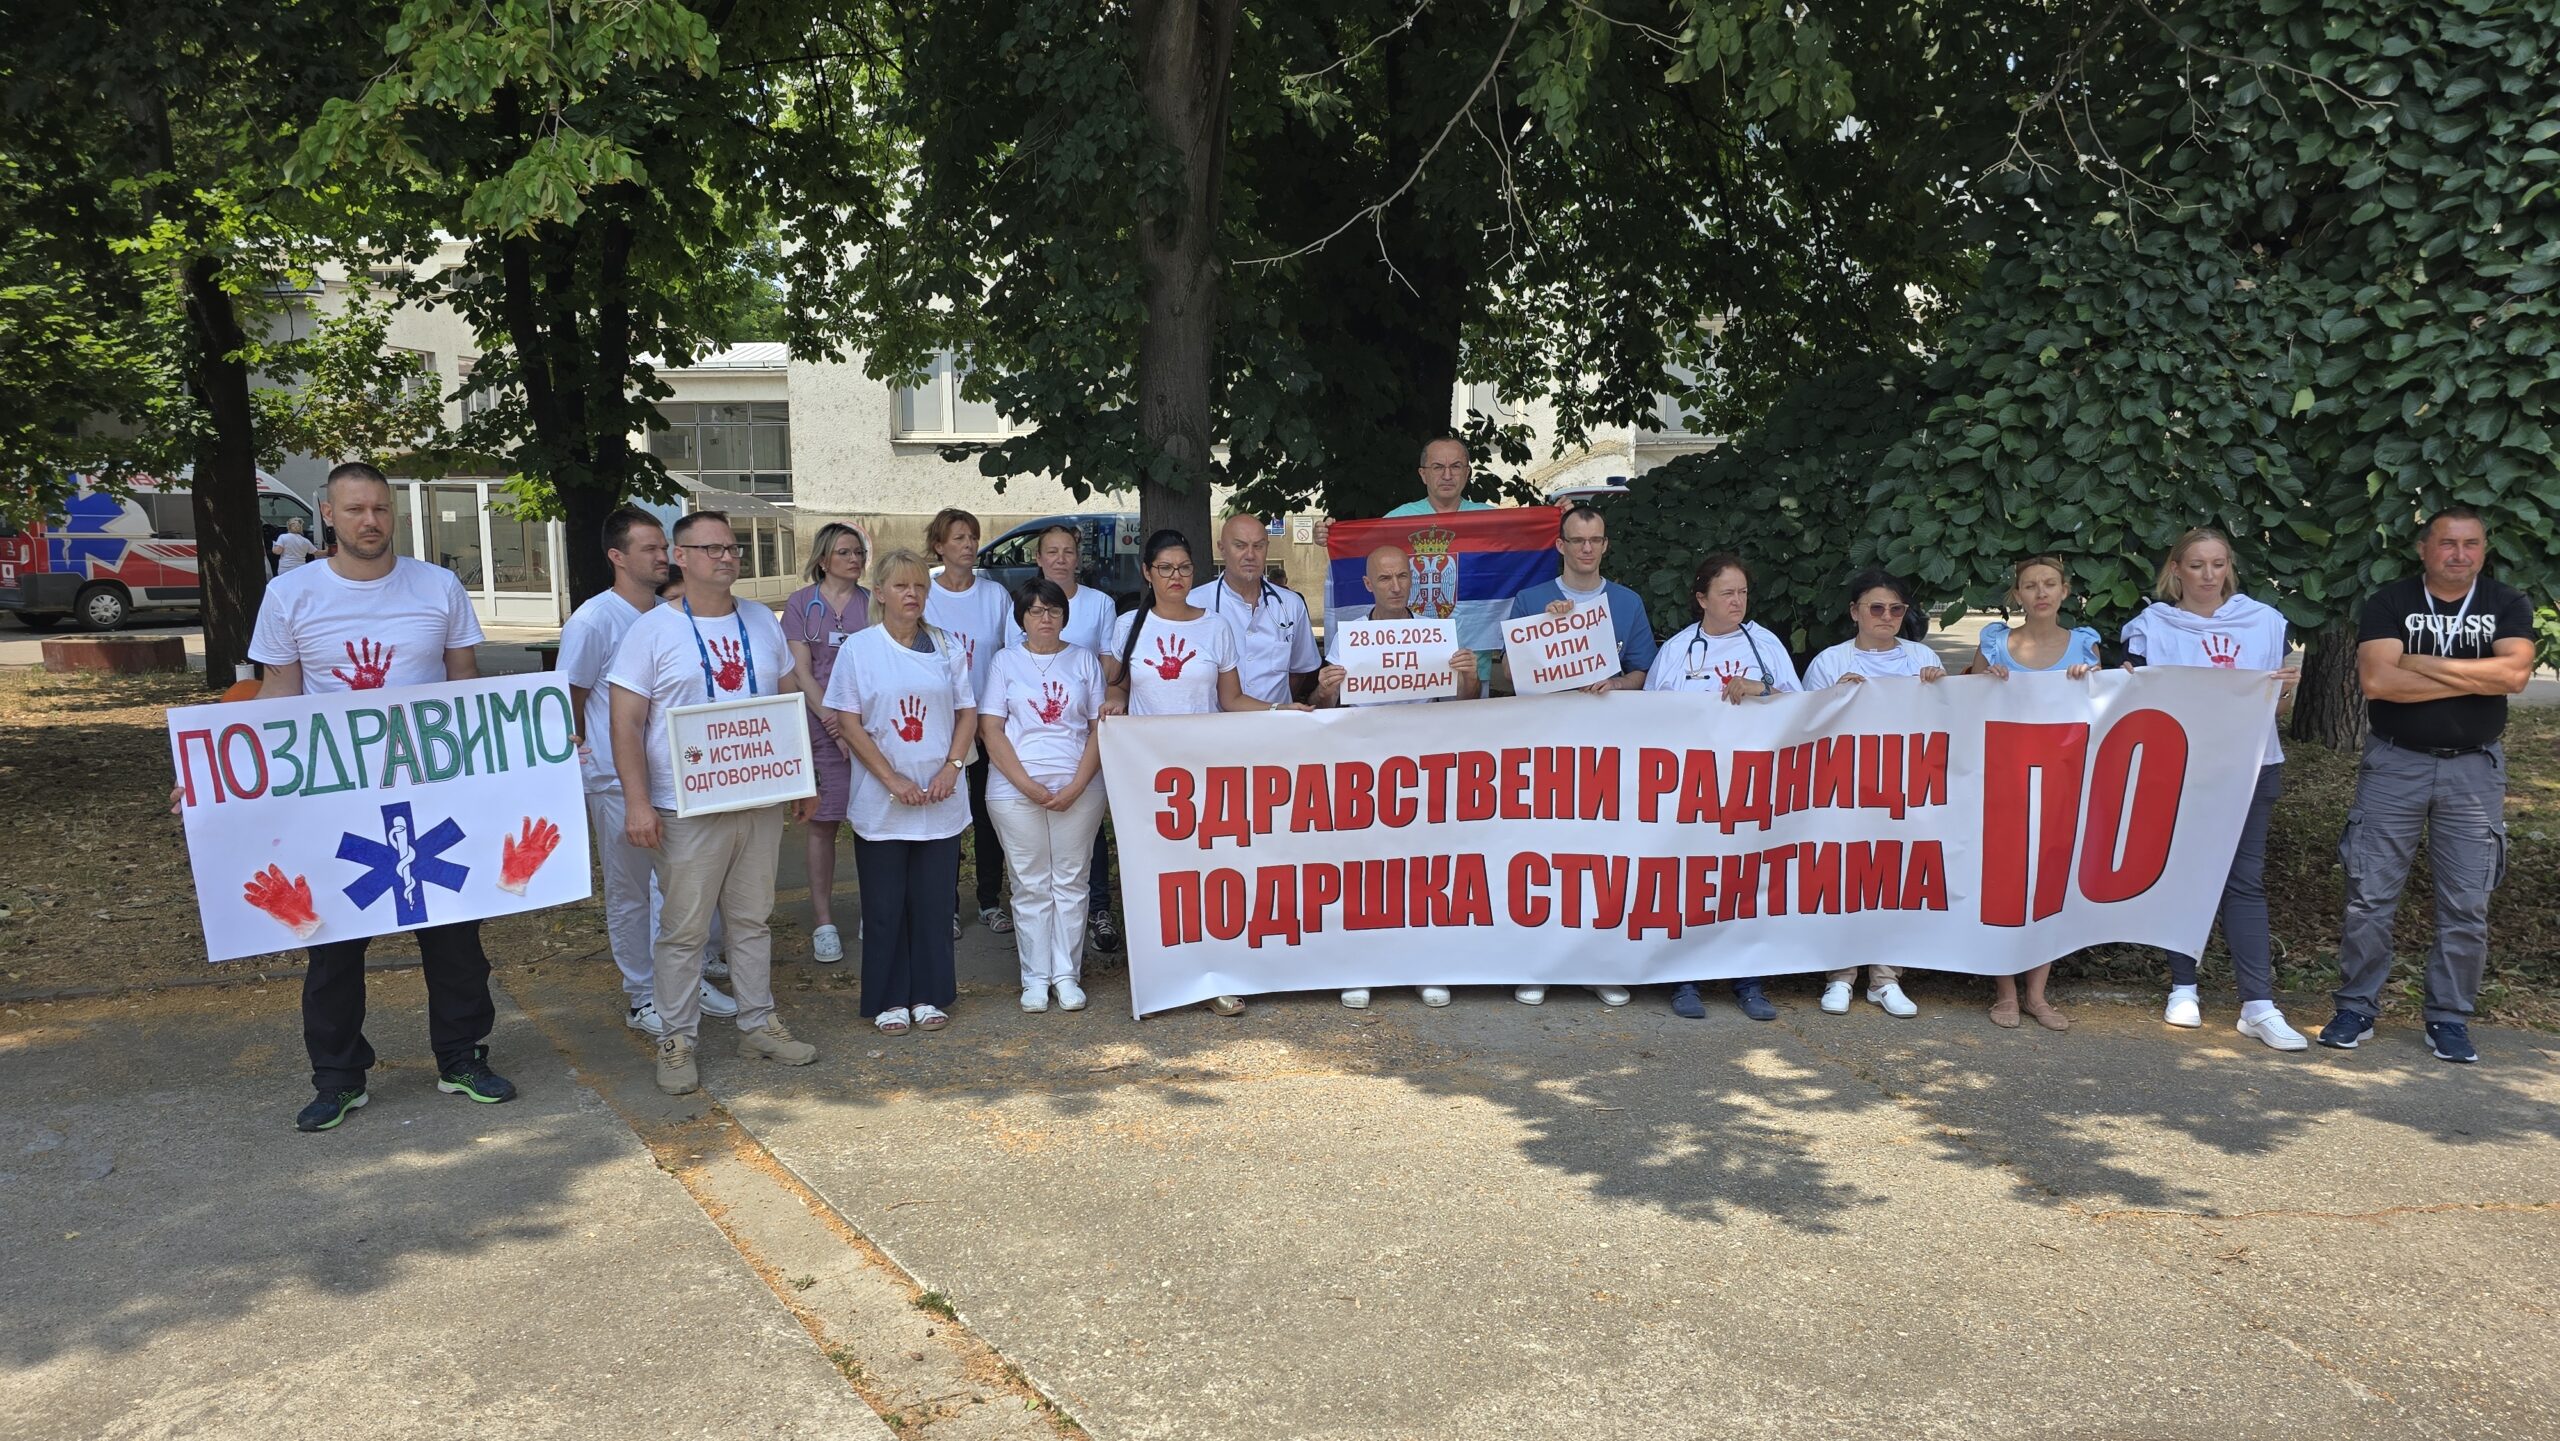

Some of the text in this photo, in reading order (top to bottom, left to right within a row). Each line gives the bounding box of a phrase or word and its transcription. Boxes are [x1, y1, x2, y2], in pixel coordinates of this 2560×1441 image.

[1349, 628, 1447, 647] 28.06.2025.
[1510, 605, 1607, 644] СЛОБОДА
[2404, 613, 2496, 640] GUESS
[1382, 651, 1418, 670] БГД
[1545, 635, 1589, 660] ИЛИ
[1347, 672, 1453, 694] ВИДОВДАН
[1533, 653, 1607, 684] НИШТА
[707, 717, 771, 740] ПРАВДА
[177, 686, 575, 807] ПОЗДРАВИМО
[710, 740, 774, 764] ИСТИНА
[685, 758, 802, 793] ОДГОВОРНОСТ
[1154, 731, 1950, 849] ЗДРАВСТВЕНИ РАДНИЦИ
[1980, 708, 2188, 927] ПО
[1158, 839, 1949, 949] ПОДРШКА СТУДЕНТИМА
